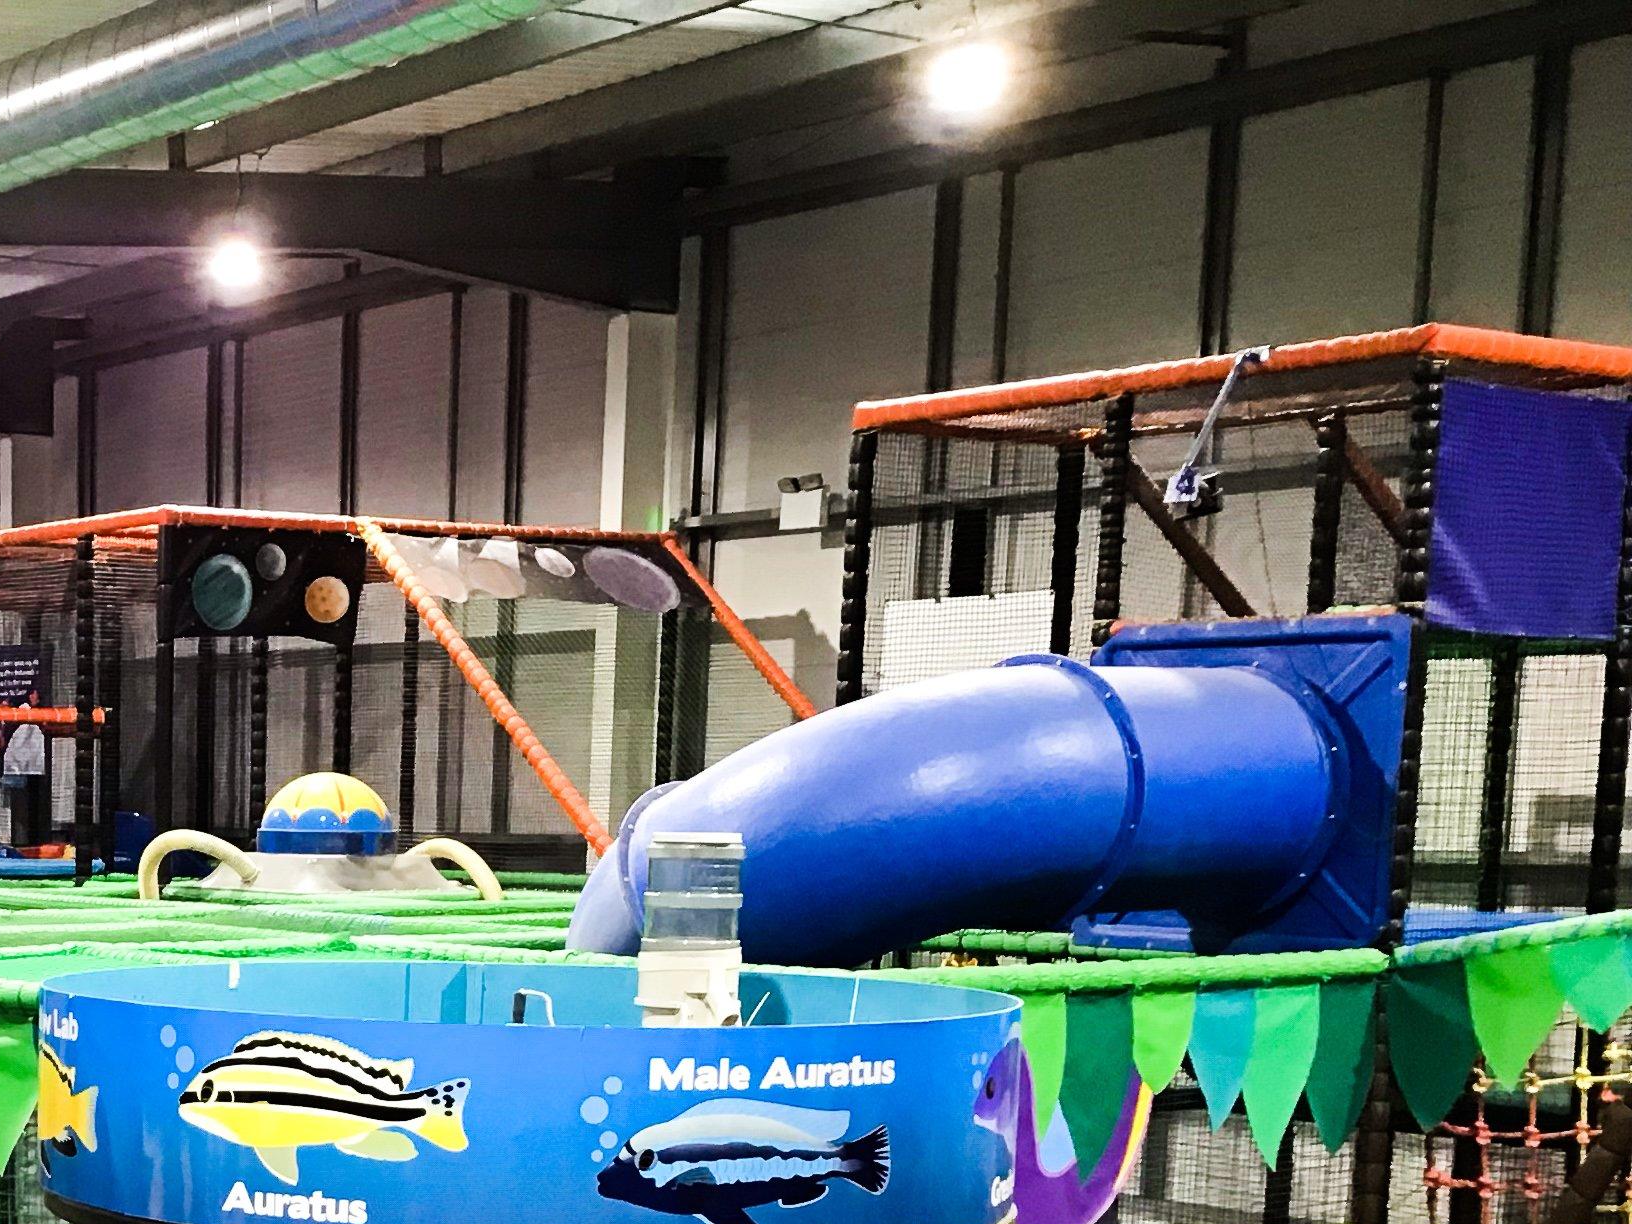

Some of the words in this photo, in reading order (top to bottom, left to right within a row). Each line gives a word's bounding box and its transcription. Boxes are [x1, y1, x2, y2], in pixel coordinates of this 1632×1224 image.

[54, 1008, 79, 1041] Lab
[650, 1056, 751, 1093] Male
[760, 1054, 895, 1090] Auratus
